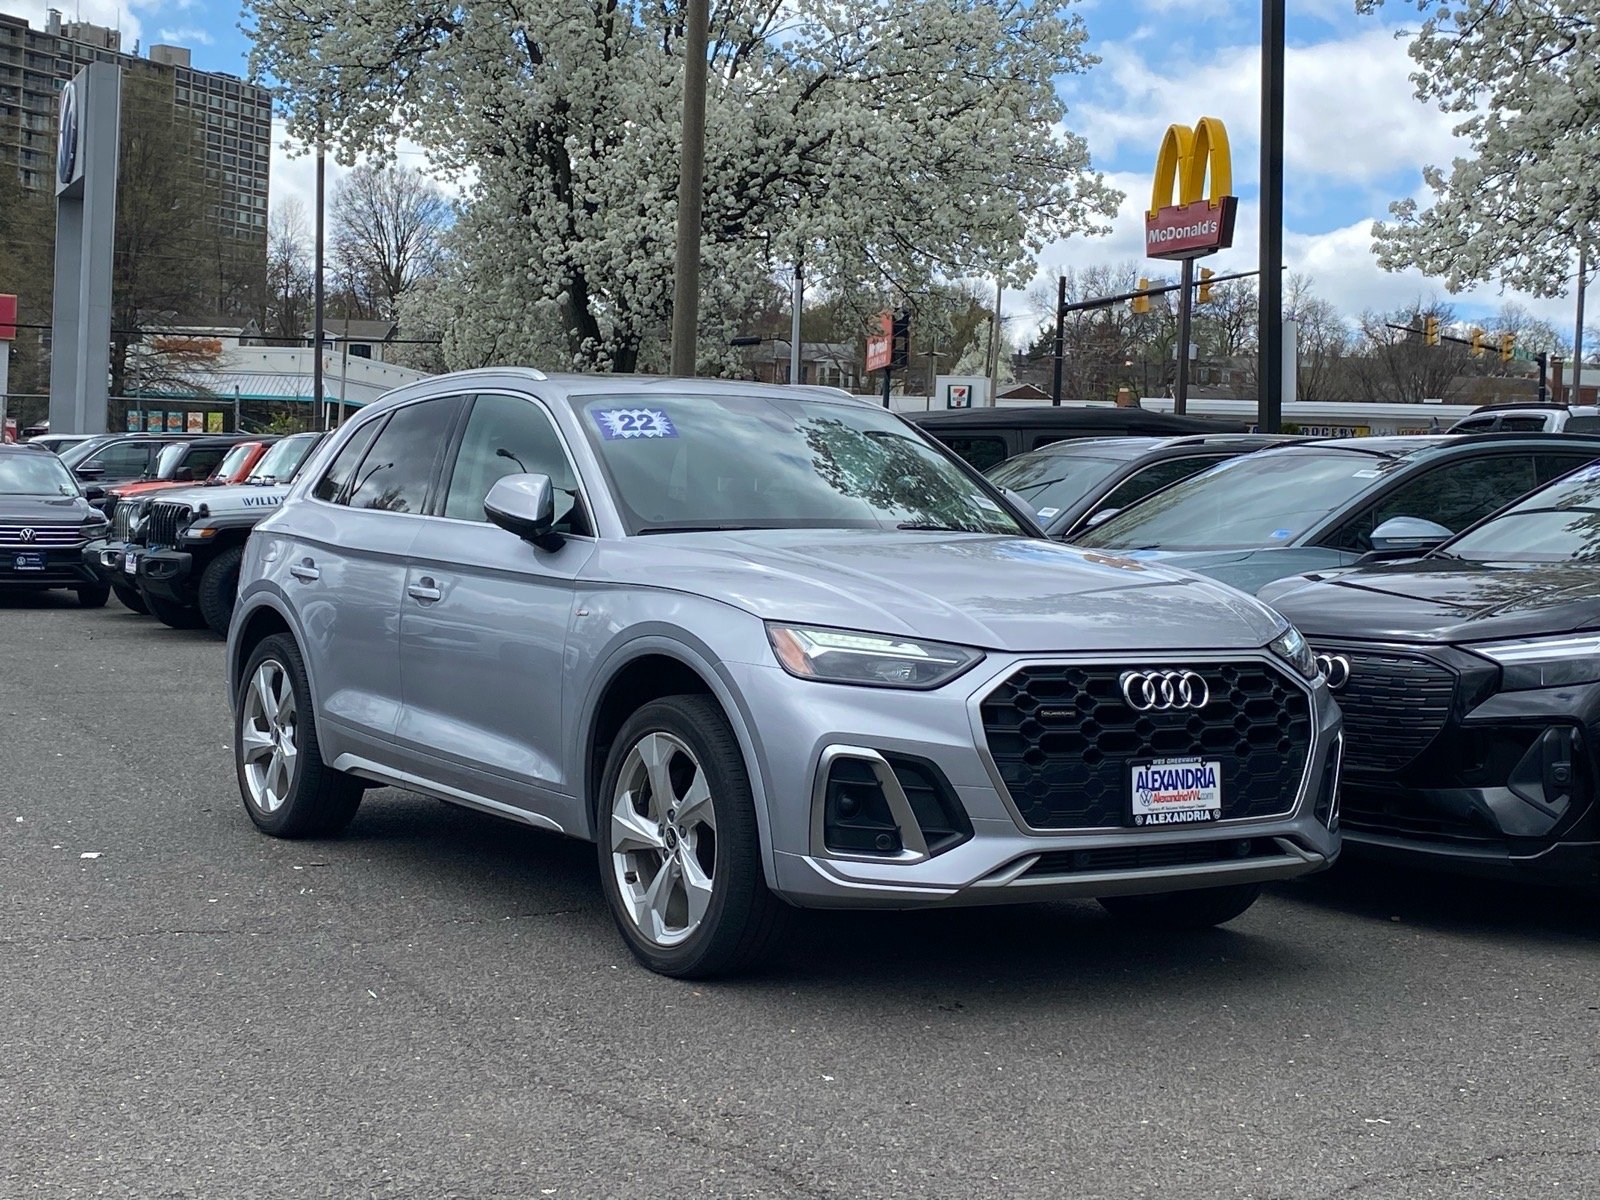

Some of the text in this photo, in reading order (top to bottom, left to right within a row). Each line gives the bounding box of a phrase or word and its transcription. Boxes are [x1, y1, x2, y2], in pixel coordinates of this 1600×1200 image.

[1148, 220, 1218, 243] McDonald's
[618, 414, 657, 431] 22
[1301, 426, 1357, 438] ROCERY
[1136, 767, 1216, 792] ALEXANDRIA
[1145, 810, 1211, 825] ALEXANDRIA
